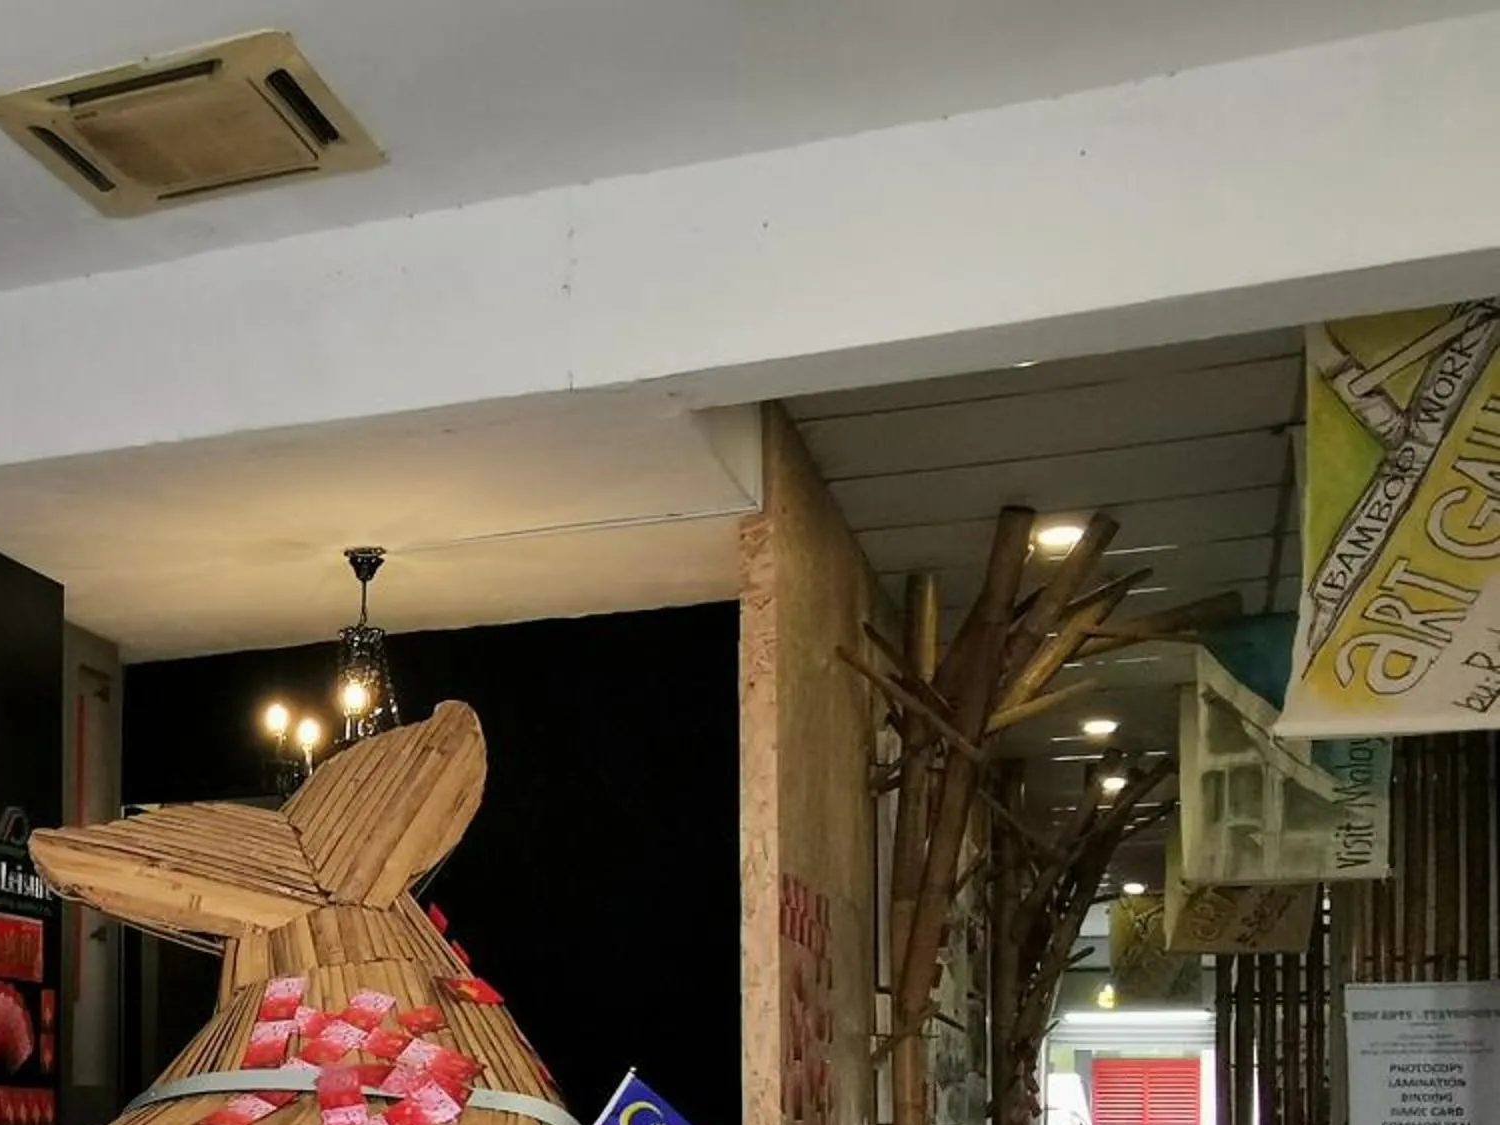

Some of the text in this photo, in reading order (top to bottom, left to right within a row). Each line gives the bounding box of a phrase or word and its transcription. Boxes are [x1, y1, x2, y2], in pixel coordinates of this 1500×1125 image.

[1334, 822, 1376, 869] Visit
[1389, 1063, 1463, 1073] PHOTOCOPY
[1387, 1078, 1466, 1088] LAMINATION
[1430, 1106, 1465, 1117] CARD
